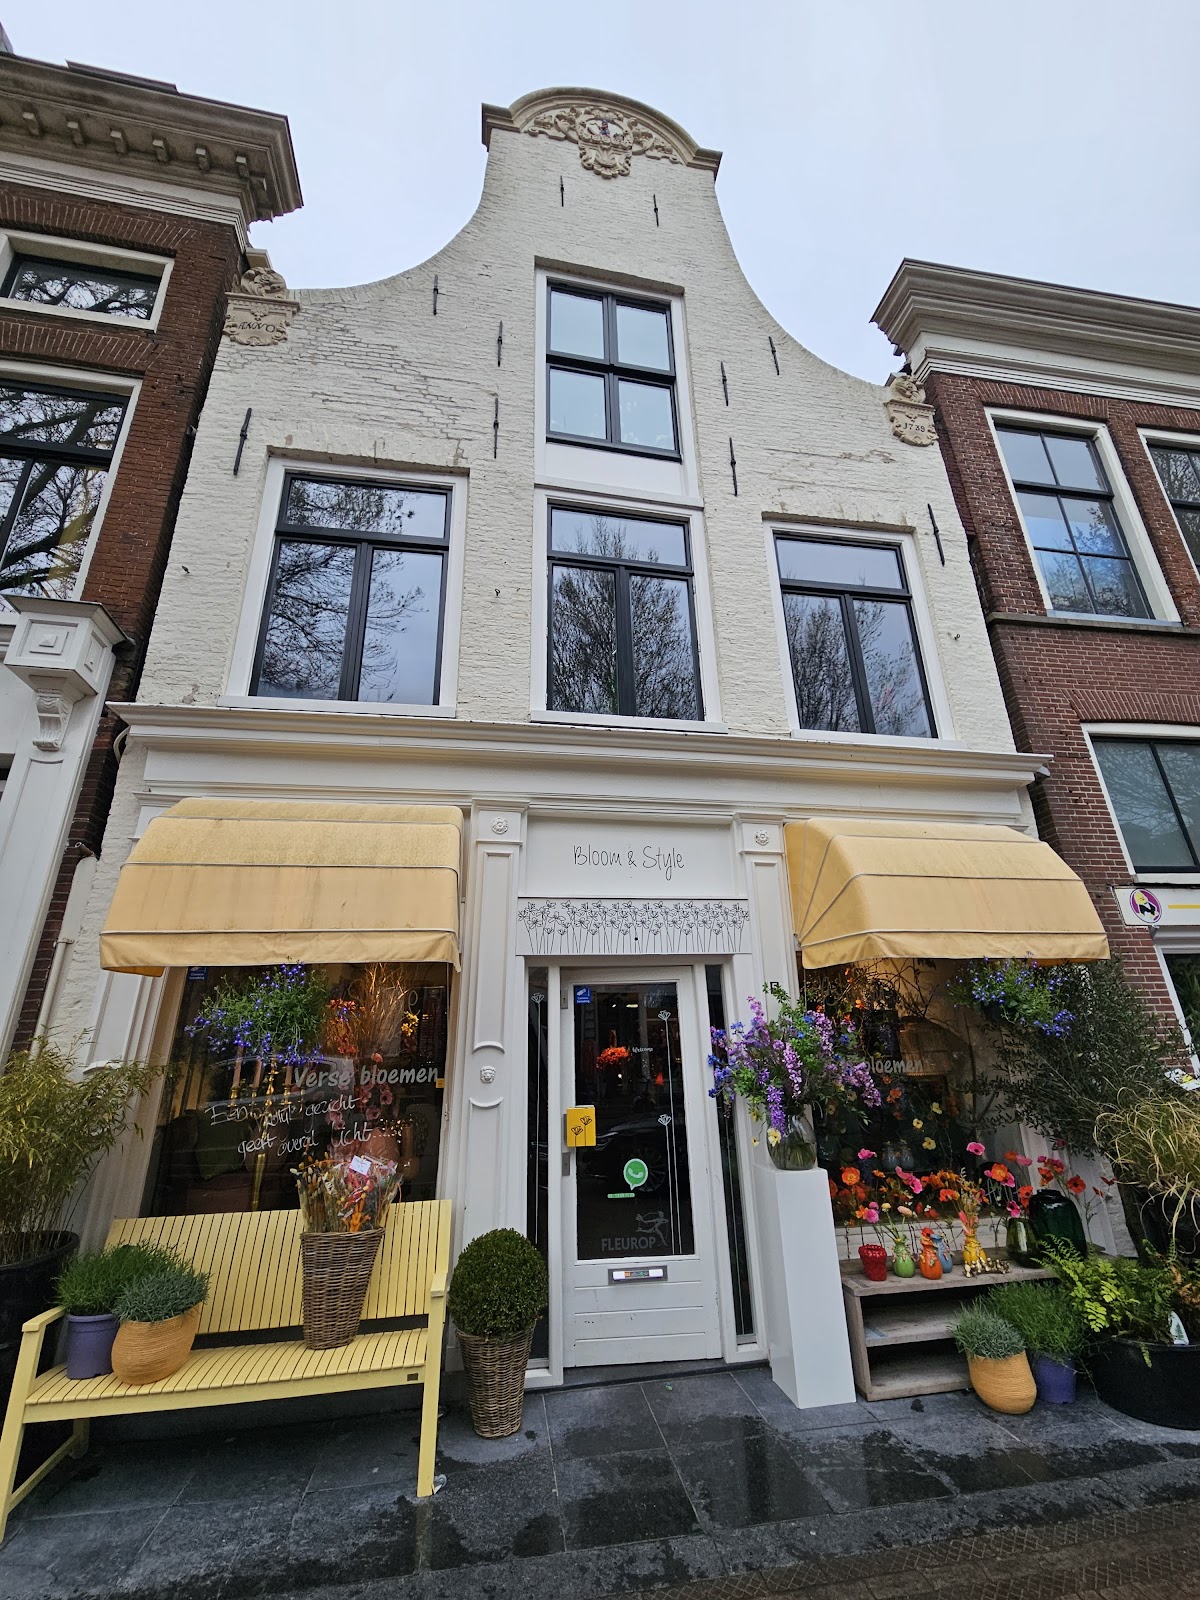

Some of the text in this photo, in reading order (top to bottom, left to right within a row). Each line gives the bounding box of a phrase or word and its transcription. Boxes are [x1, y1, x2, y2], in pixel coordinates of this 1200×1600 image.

[573, 844, 685, 881] Bloom & Style
[294, 1066, 351, 1088] Verse
[359, 1064, 438, 1086] bloemen
[305, 1094, 361, 1134] gezicht
[601, 1237, 656, 1251] FLEUROP
